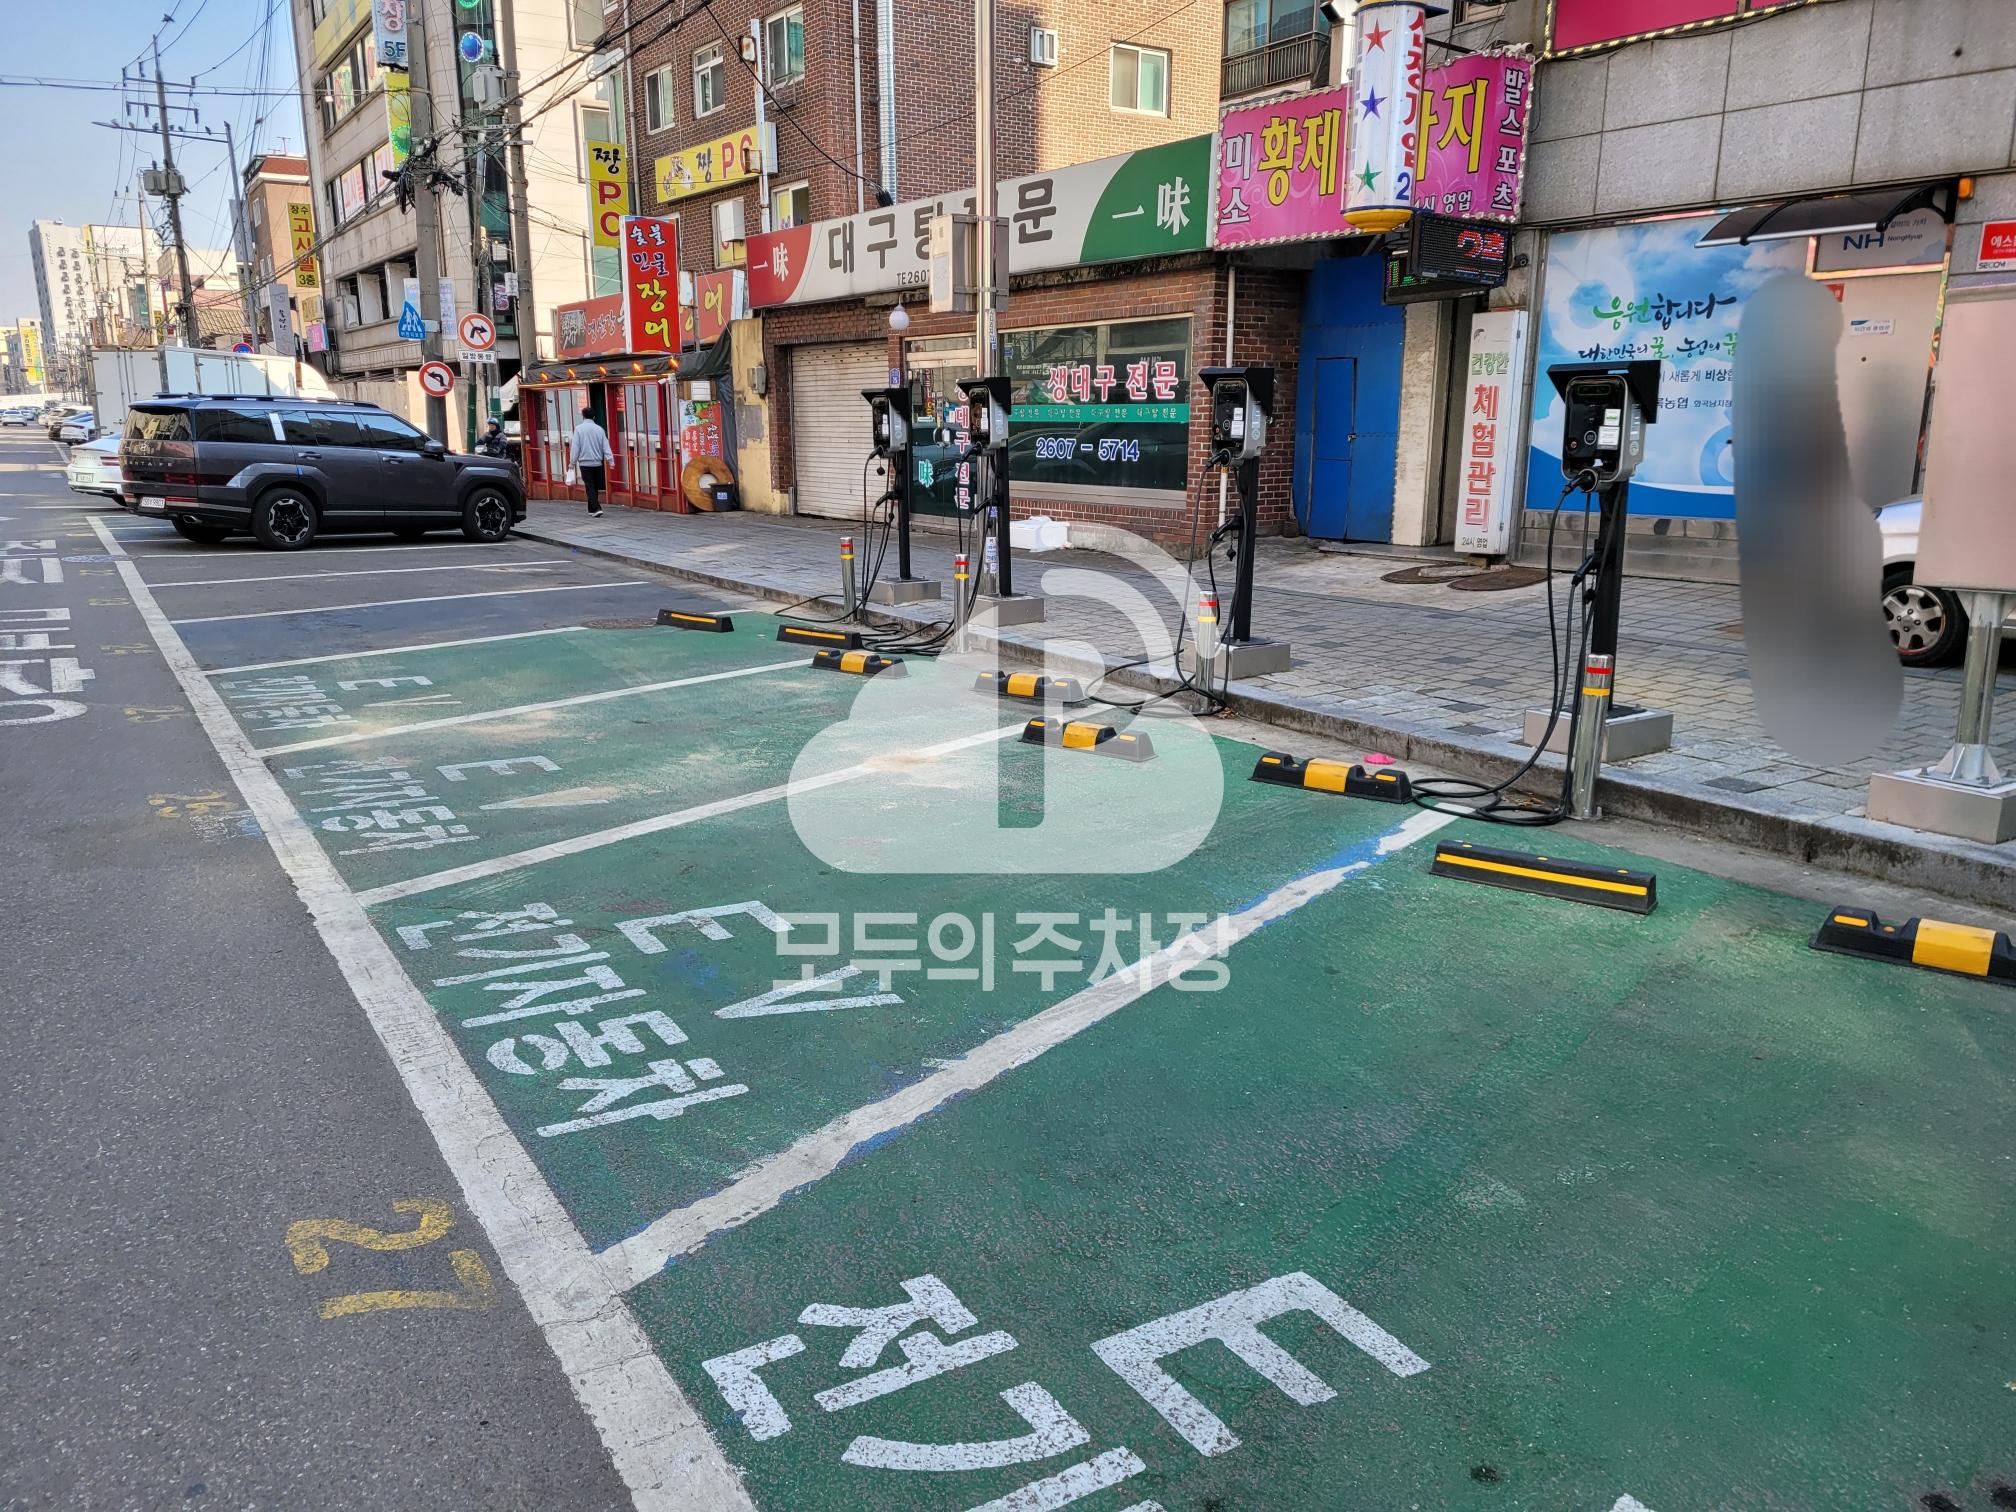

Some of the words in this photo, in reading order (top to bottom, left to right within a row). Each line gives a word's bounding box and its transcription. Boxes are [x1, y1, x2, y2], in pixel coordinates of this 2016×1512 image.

[384, 40, 405, 58] 5F
[1220, 133, 1253, 225] 미소
[1111, 176, 1190, 236] 一味
[1442, 190, 1473, 214] 영업
[1843, 233, 1885, 250] NH
[1991, 235, 2016, 248] 에스
[753, 242, 789, 282] 一味
[299, 274, 316, 286] 3층
[897, 269, 930, 286] TE260
[1593, 292, 1737, 331] 응원합니다
[1578, 343, 1648, 361] 대한민국의
[1048, 364, 1116, 403] 생대구
[1125, 361, 1179, 401] 전문
[1036, 438, 1077, 460] 2607
[1098, 438, 1139, 462] 5714
[1465, 383, 1499, 534] 체험관리
[396, 901, 750, 1138] 전기자동차
